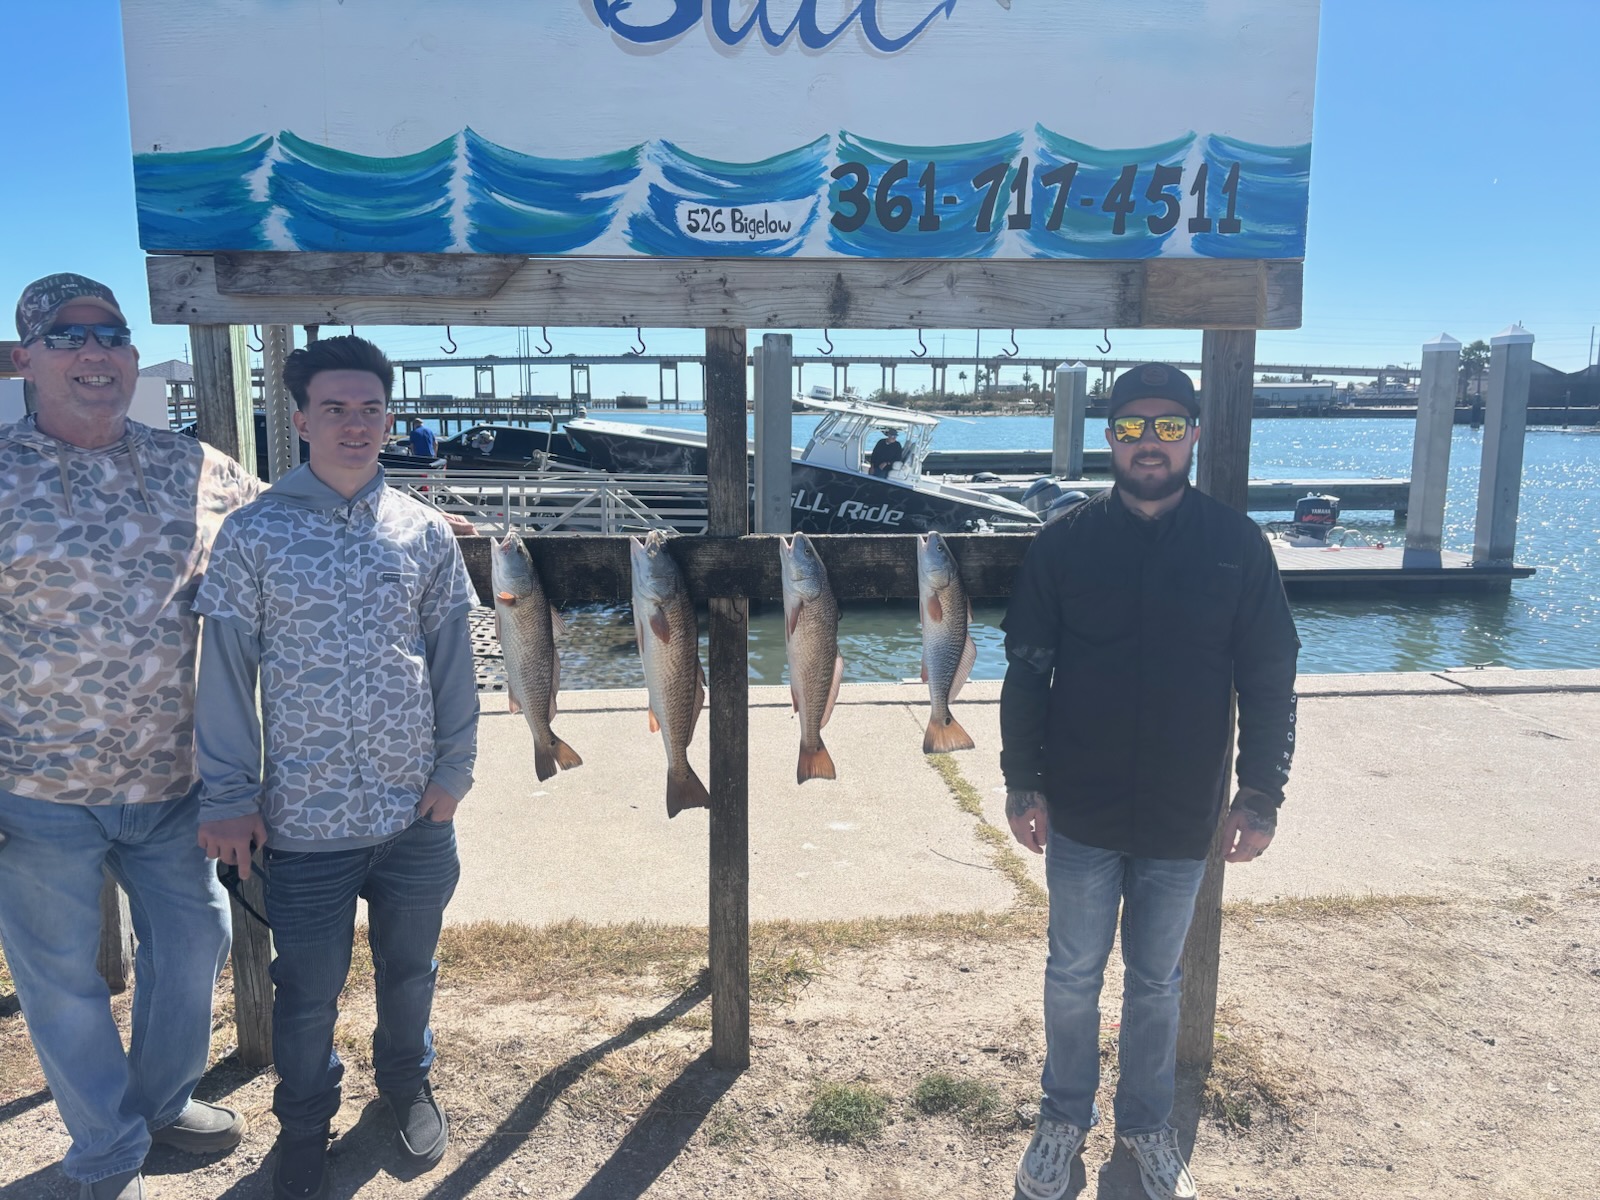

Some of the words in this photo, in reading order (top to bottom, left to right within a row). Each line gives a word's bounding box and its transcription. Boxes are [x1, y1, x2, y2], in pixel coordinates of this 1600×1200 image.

[830, 156, 1241, 235] 361-717-4511
[686, 207, 726, 233] 526
[731, 207, 792, 240] Bigelow
[837, 500, 904, 526] Ride
